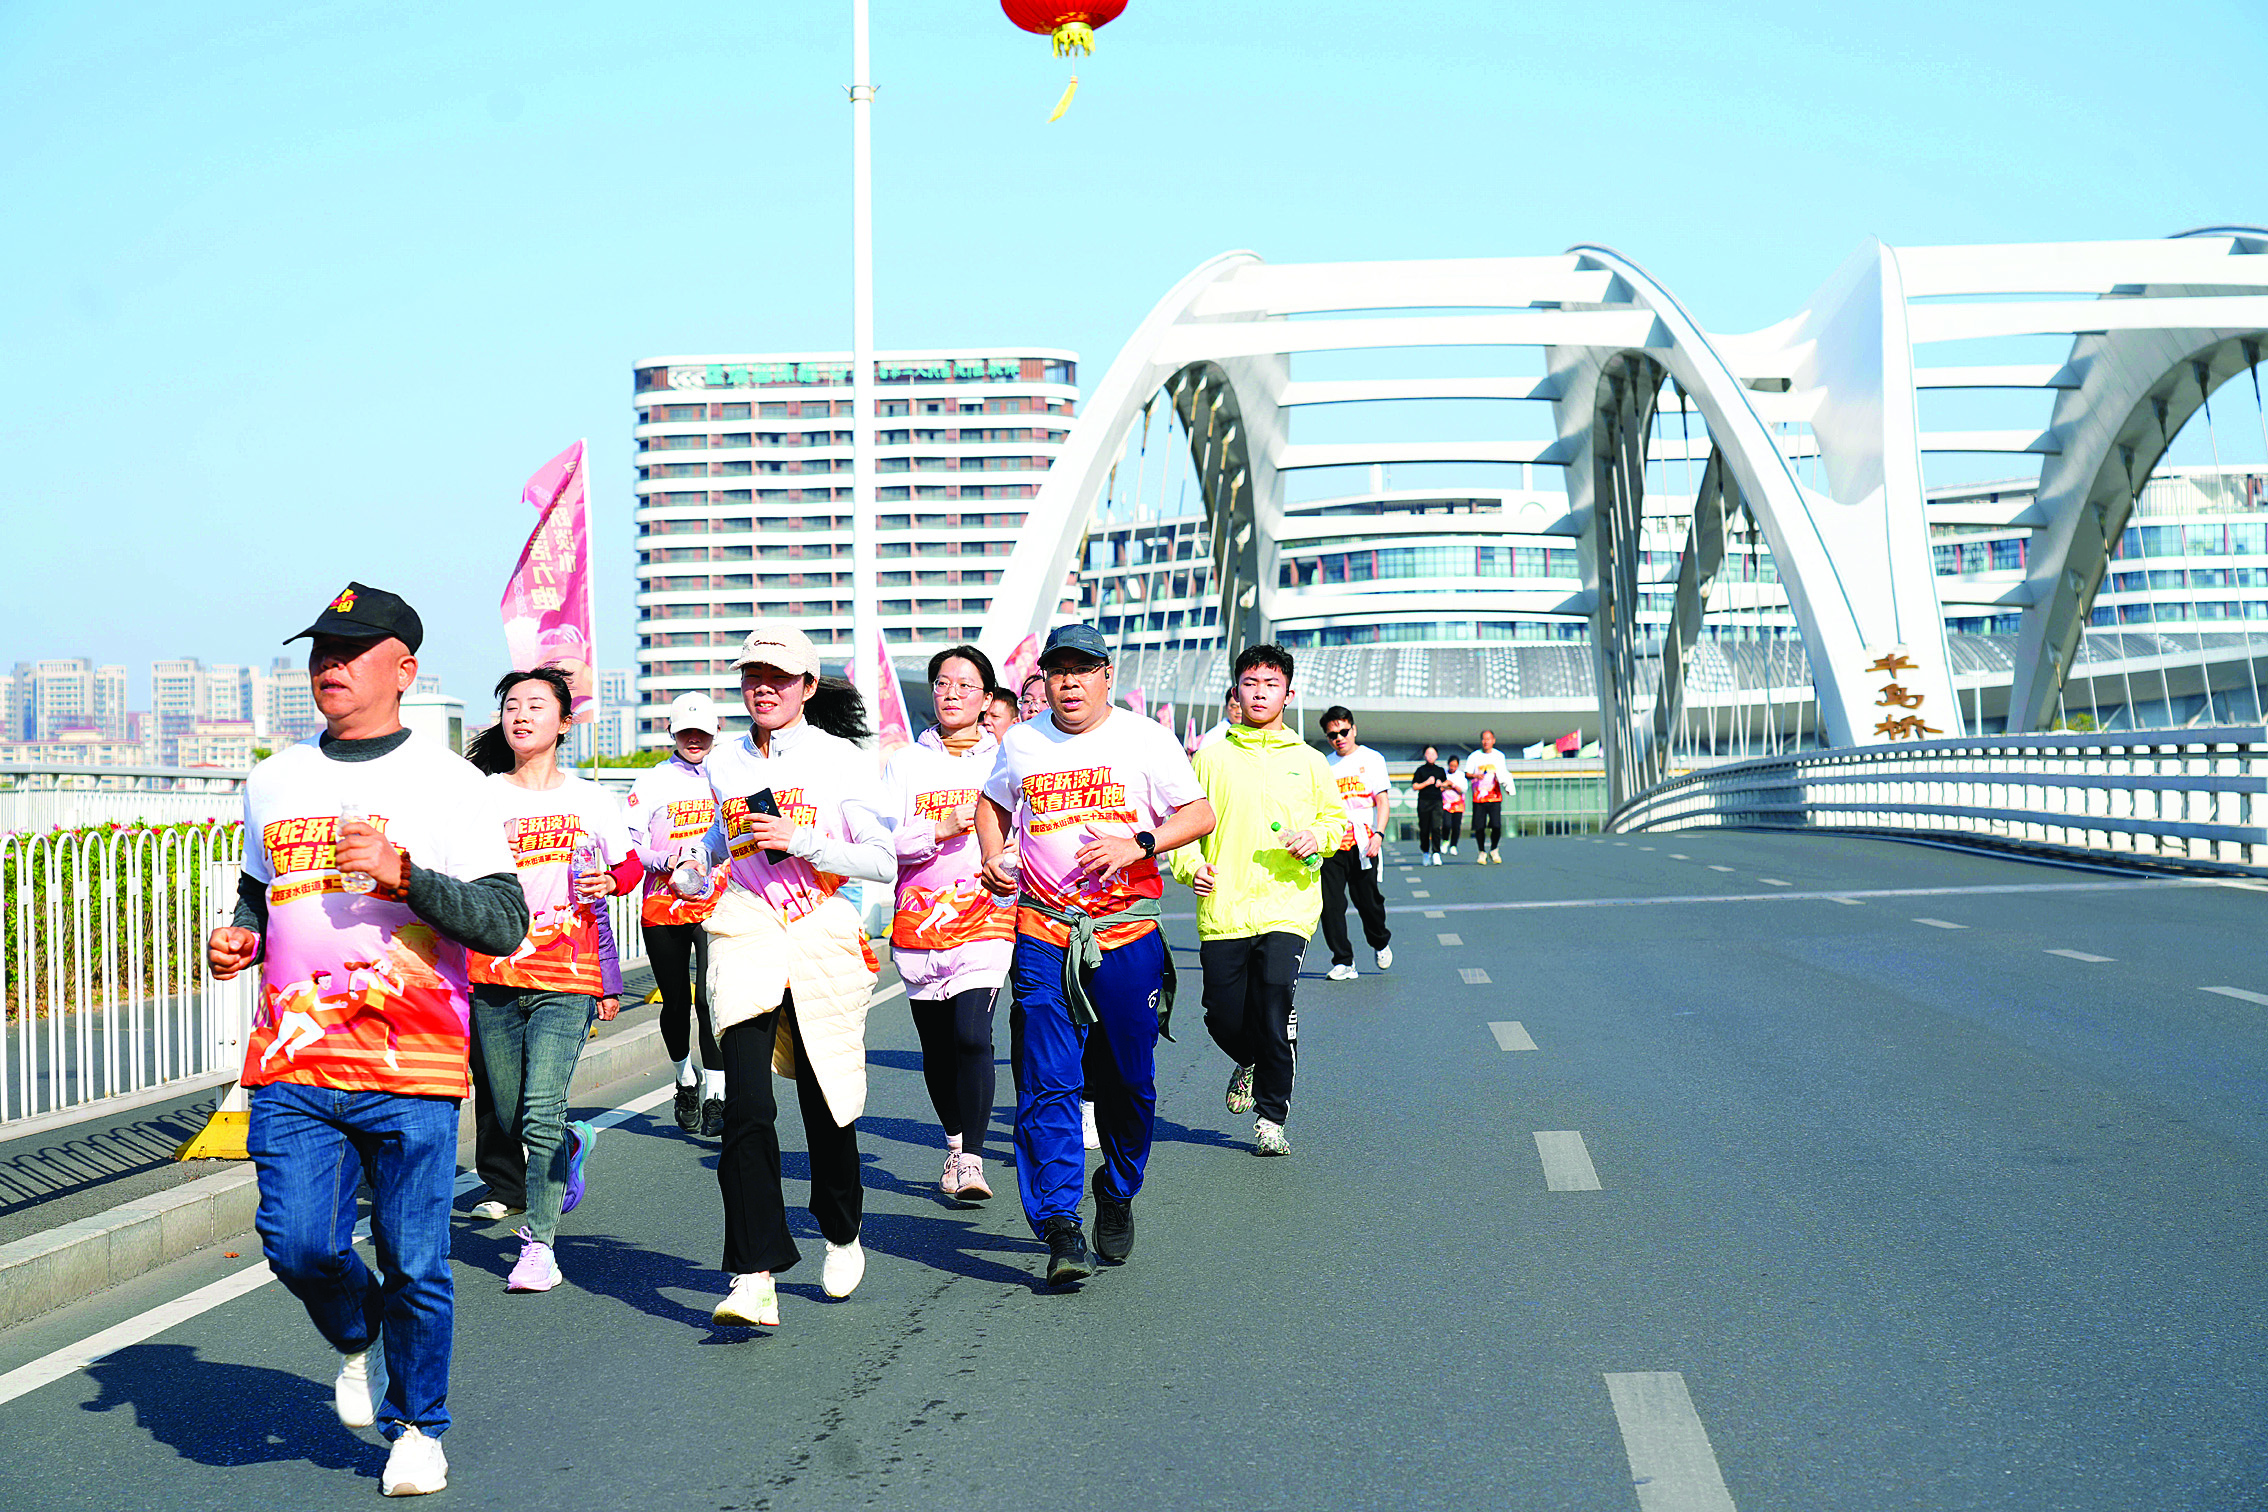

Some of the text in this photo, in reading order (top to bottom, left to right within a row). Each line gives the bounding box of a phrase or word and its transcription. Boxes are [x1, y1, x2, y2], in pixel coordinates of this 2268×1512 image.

[1021, 766, 1111, 802] 灵蛇跃淡水
[1030, 783, 1126, 815] 新春活力跑
[674, 810, 715, 827] 新春活
[722, 788, 803, 827] 灵蛇水
[914, 788, 983, 816] 灵蛇跃淡
[264, 815, 389, 861] 灵蛇跃水
